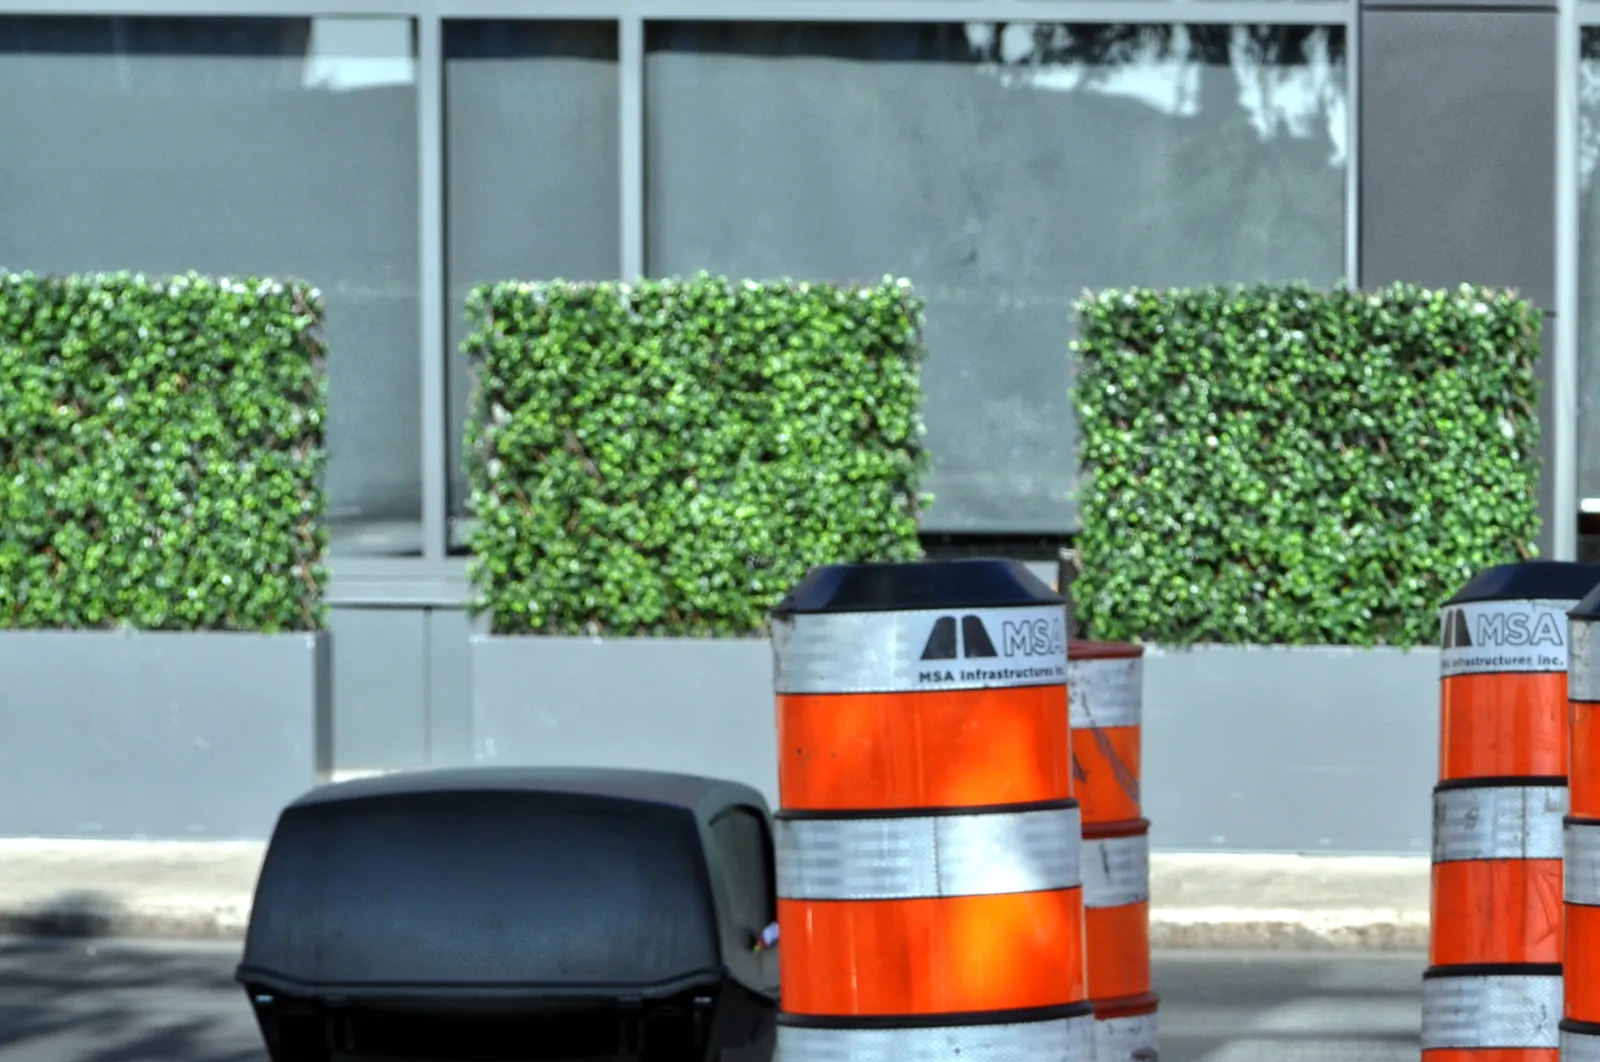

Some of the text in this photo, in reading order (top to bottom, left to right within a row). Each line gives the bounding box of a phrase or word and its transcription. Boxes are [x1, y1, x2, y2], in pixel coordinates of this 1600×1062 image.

[1003, 617, 1065, 657] MSA
[1477, 612, 1564, 646] MSA
[1537, 654, 1564, 666] Inc.
[919, 671, 955, 682] MSA
